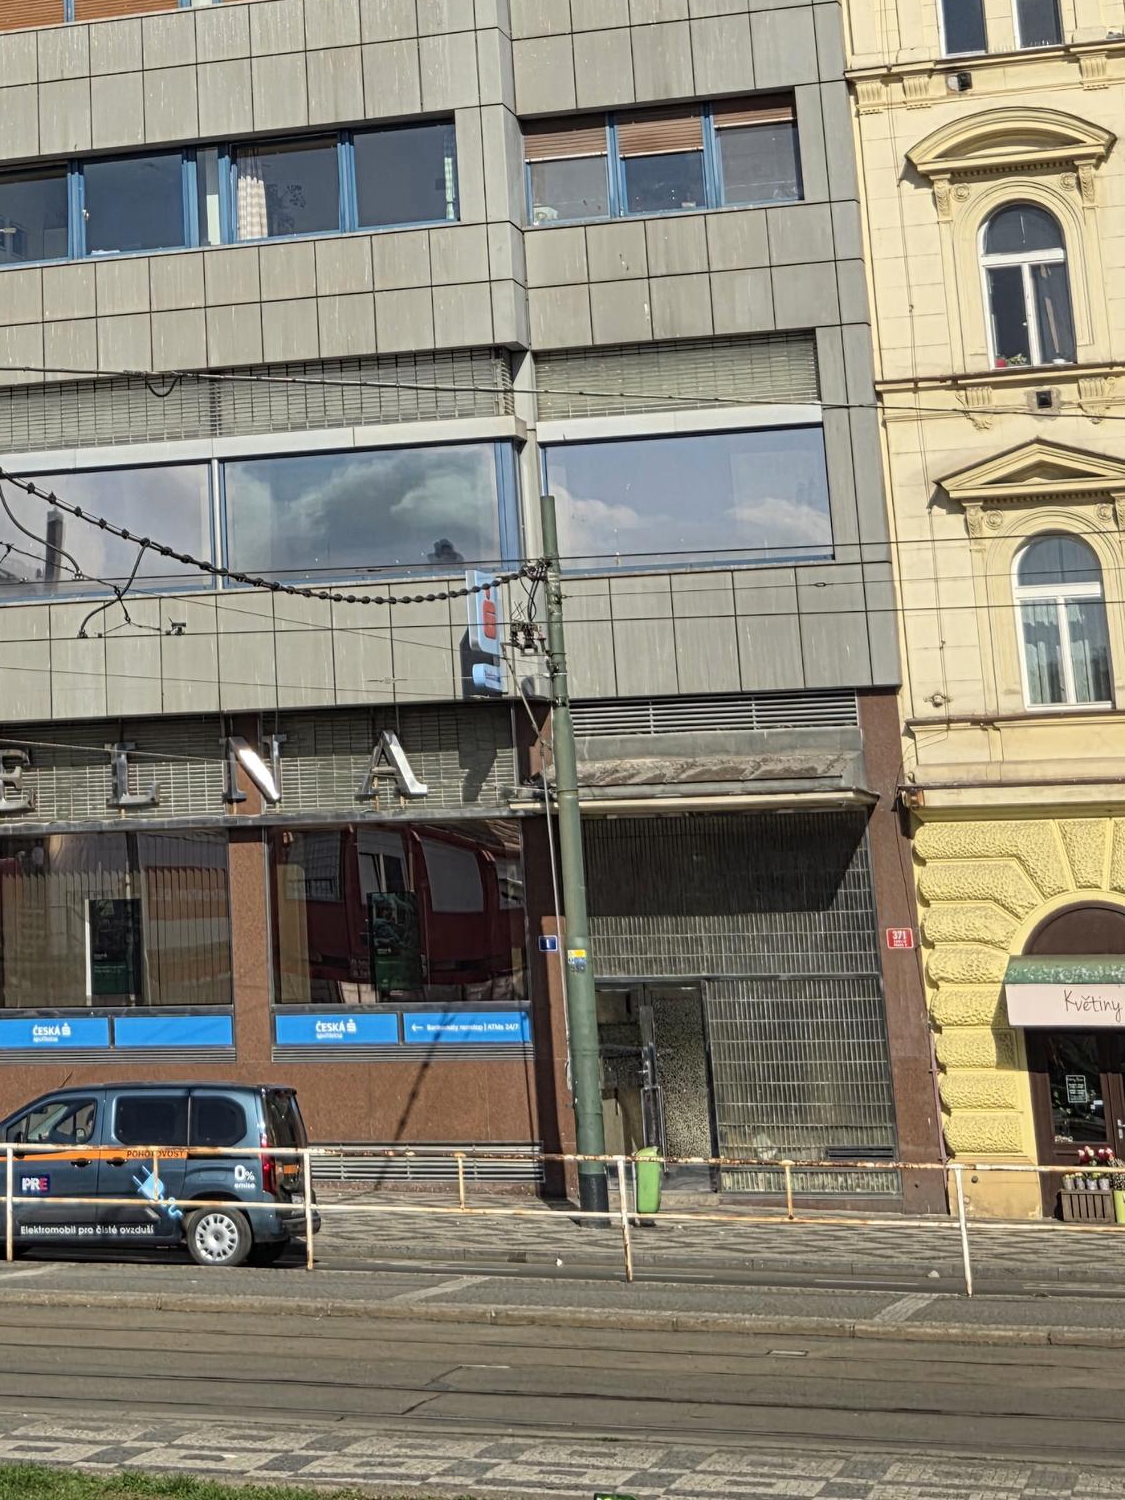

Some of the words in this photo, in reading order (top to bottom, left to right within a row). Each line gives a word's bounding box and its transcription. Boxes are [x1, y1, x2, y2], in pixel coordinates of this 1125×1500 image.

[892, 930, 906, 940] 371
[1064, 989, 1123, 1023] Květiny
[33, 1024, 60, 1036] ČESKÁ
[316, 1020, 345, 1032] ČESKÁ
[505, 1022, 518, 1030] 24/7
[127, 1150, 183, 1158] POHOTOVOST
[235, 1164, 255, 1181] 0%
[22, 1177, 48, 1191] PRE
[20, 1225, 76, 1235] Elektromobil
[78, 1227, 94, 1237] pro
[96, 1224, 117, 1235] čisté
[119, 1224, 155, 1235] ovzduší
